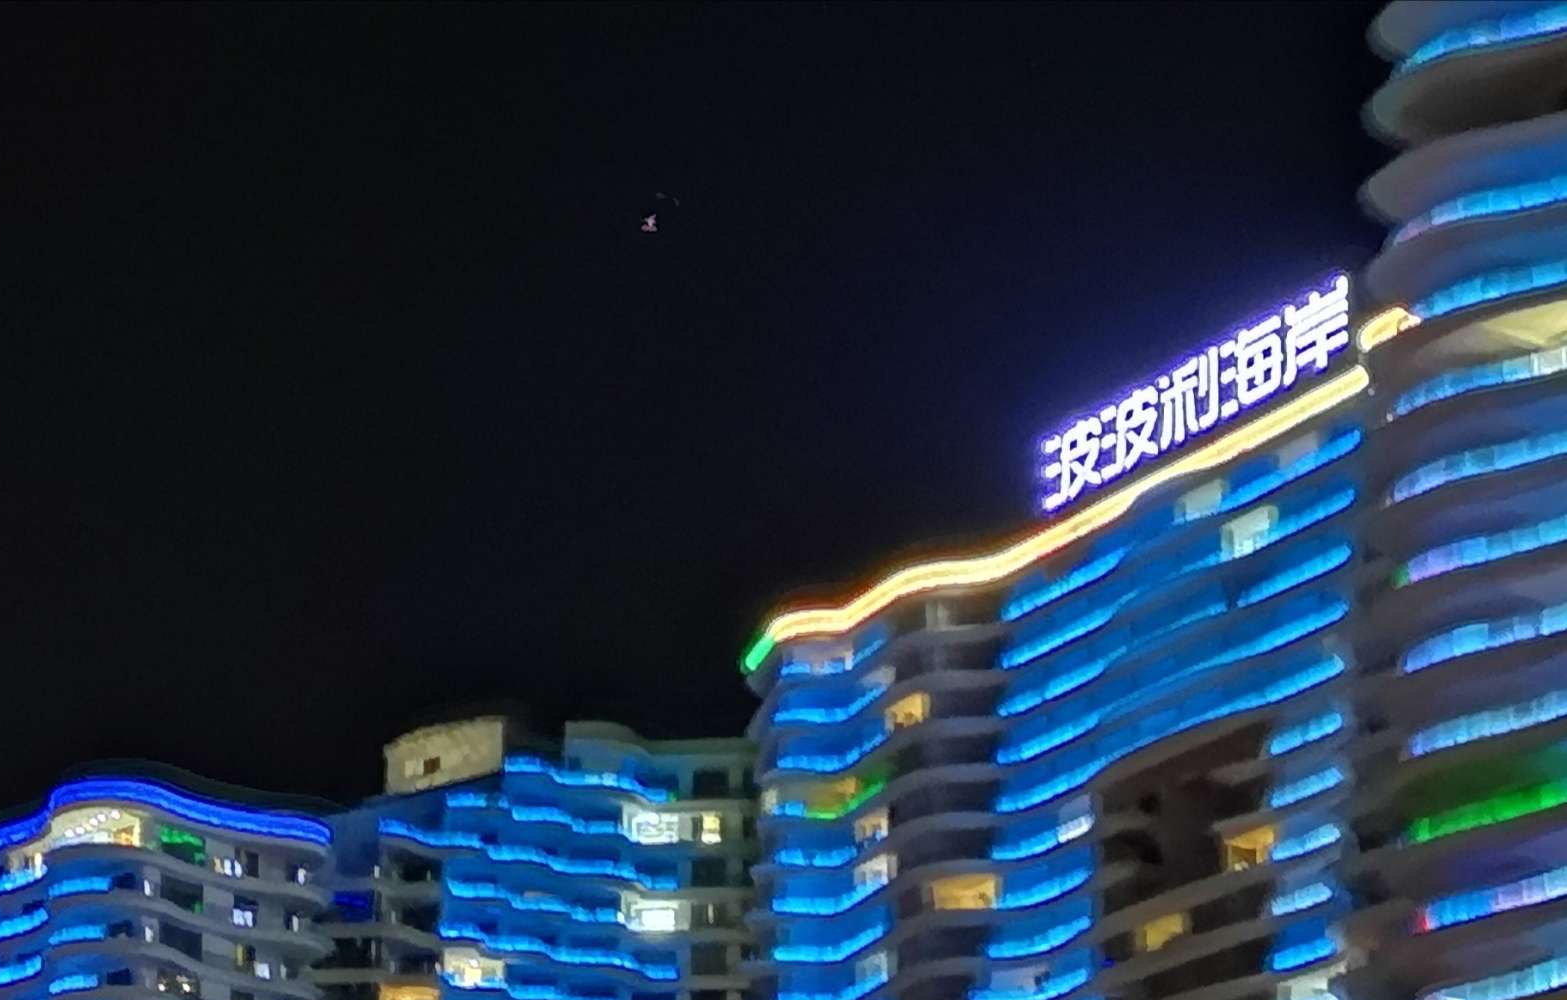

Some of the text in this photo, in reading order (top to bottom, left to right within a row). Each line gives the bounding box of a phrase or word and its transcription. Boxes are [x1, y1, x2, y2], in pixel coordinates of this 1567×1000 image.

[1043, 274, 1349, 509] 波波利海岸
